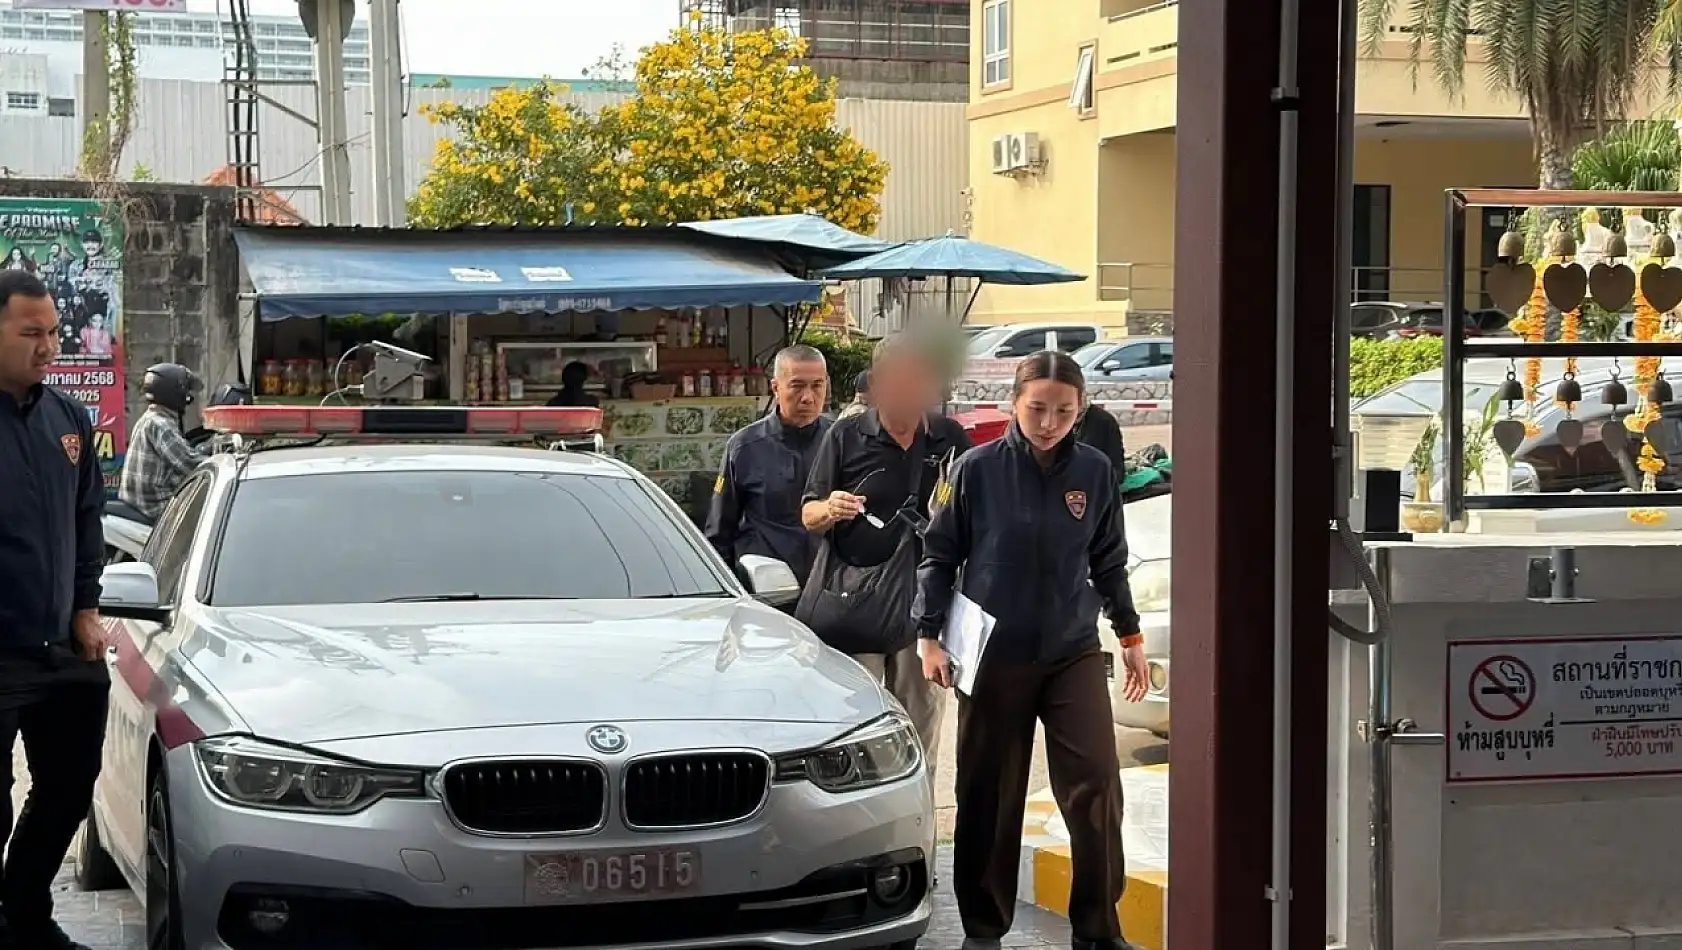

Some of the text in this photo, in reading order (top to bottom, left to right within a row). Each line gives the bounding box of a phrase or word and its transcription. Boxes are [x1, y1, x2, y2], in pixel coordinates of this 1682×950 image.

[83, 371, 114, 385] 2568
[1457, 711, 1555, 761] ห้ามสูบบุหรี่
[1605, 742, 1673, 759] 5,000 บาท
[582, 851, 693, 891] 06515
